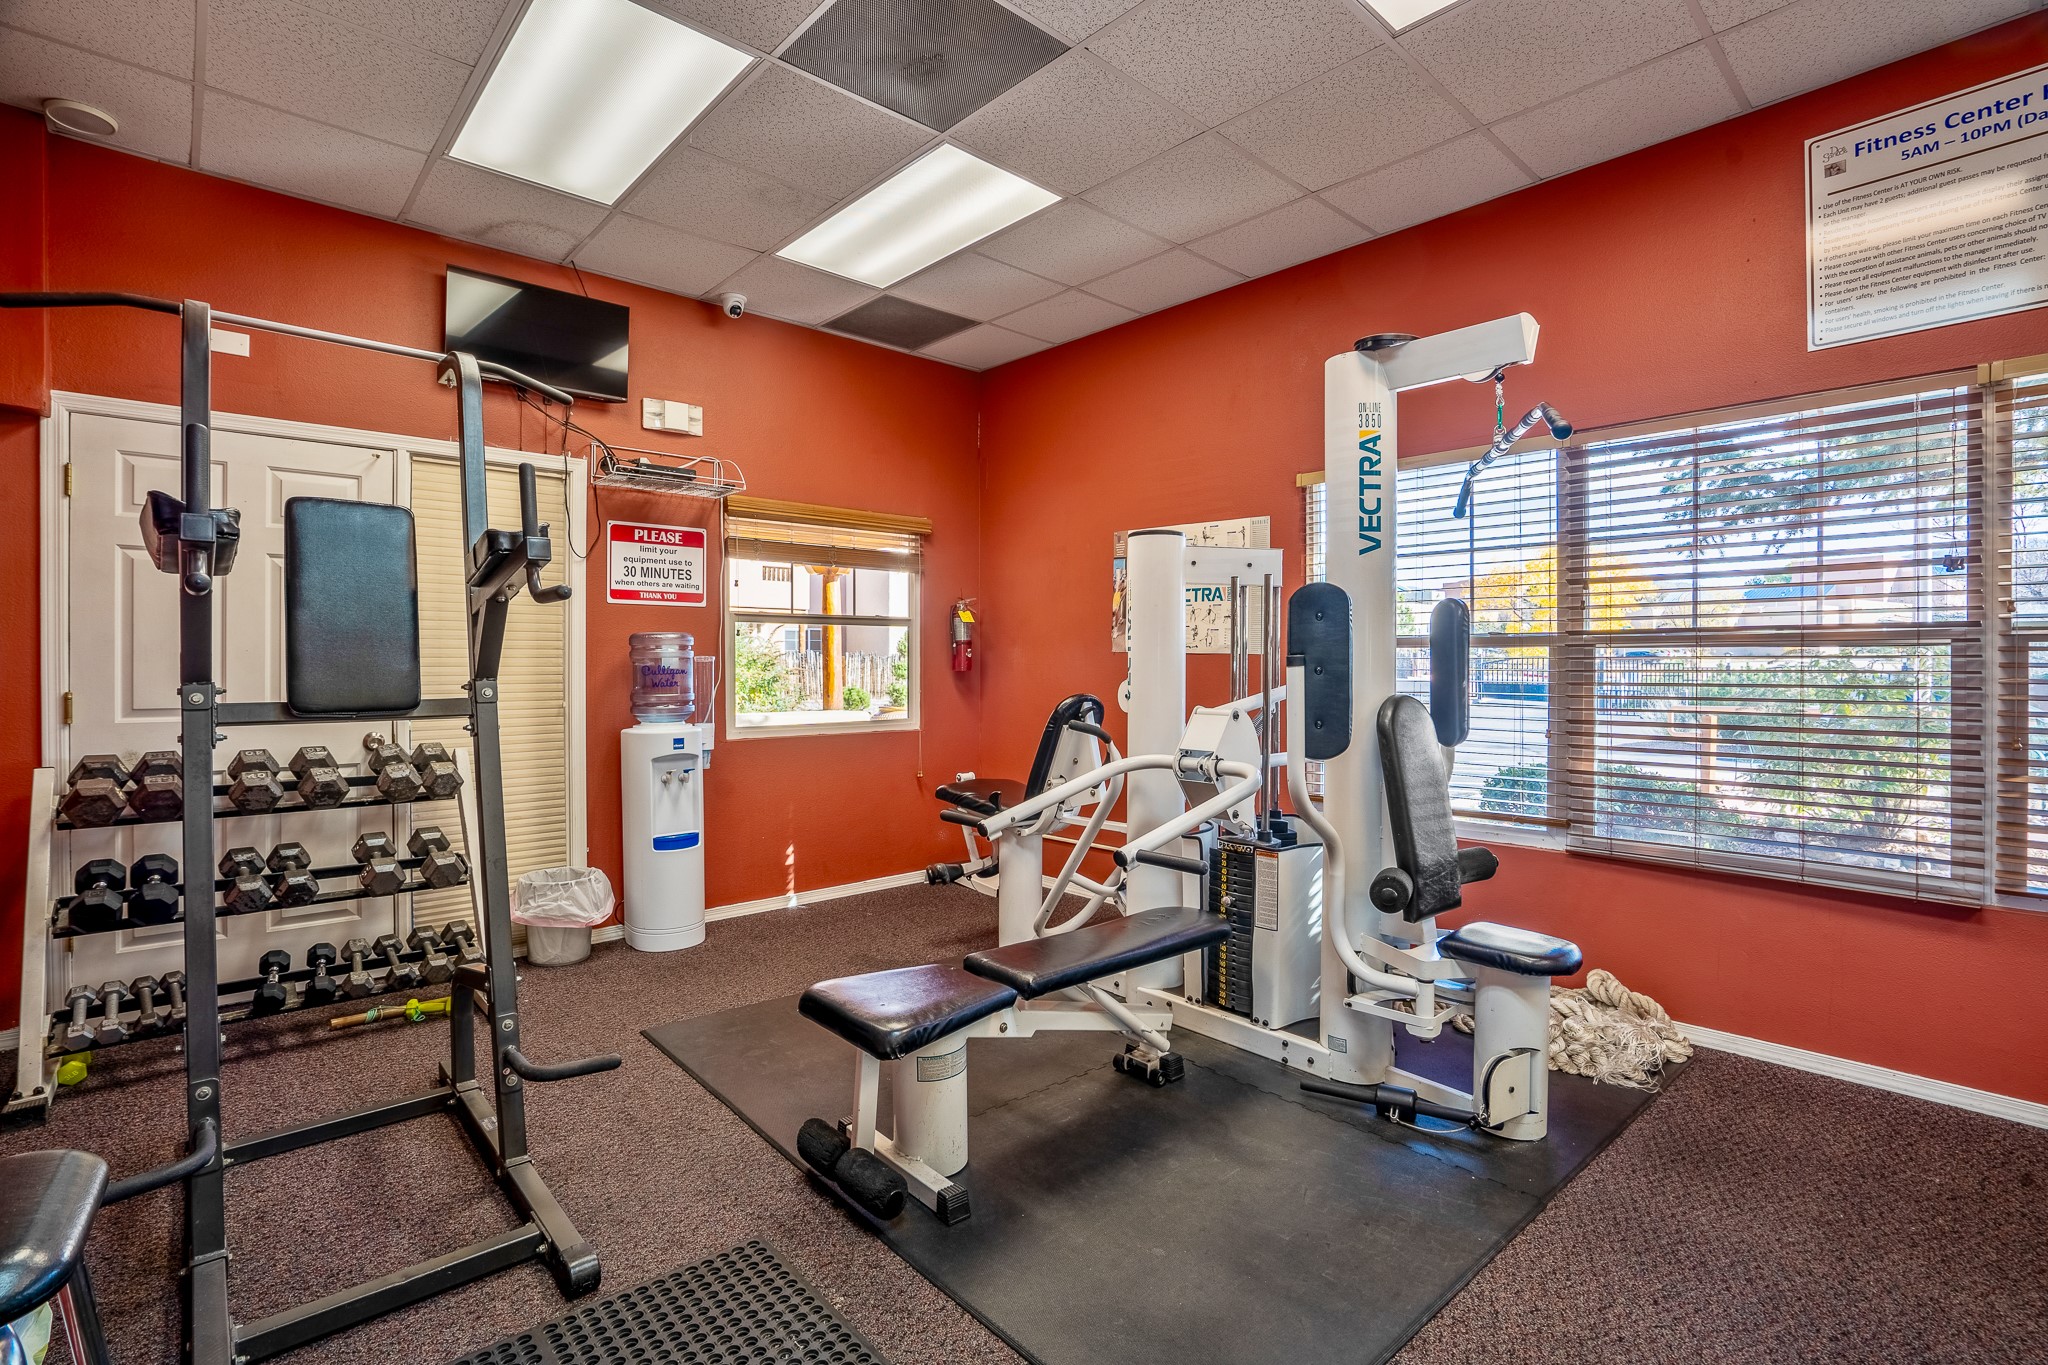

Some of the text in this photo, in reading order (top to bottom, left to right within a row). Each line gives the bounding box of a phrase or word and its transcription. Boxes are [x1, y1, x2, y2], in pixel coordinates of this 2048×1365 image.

[1854, 123, 1936, 157] Fitness
[1944, 93, 2033, 130] Center
[1901, 140, 1939, 161] 5AM
[1961, 119, 2011, 143] 10PM
[1824, 210, 1836, 218] Each
[1838, 207, 1849, 215] Unit
[1885, 193, 1905, 203] guests;
[1907, 183, 1937, 196] additional
[1939, 178, 1956, 189] guest
[1958, 173, 1979, 184] passes
[1981, 168, 1995, 176] may
[2007, 154, 2042, 169] requested
[1853, 193, 1872, 202] Fitness
[1873, 187, 1893, 196] Center
[1900, 181, 1908, 189] AT
[1910, 176, 1927, 186] YOUR
[1928, 171, 1945, 181] OWN
[1947, 167, 1963, 176] RISK.
[2020, 185, 2043, 195] Center
[1824, 263, 1842, 271] Please
[1843, 256, 1871, 267] cooperate
[1873, 251, 1885, 260] with
[1905, 243, 1925, 252] Fitness
[1927, 238, 1948, 247] Center
[1949, 233, 1966, 241] users
[1967, 224, 2003, 237] concerning
[2005, 219, 2026, 228] choice
[2028, 215, 2036, 223] of
[1829, 253, 1847, 261] others
[1859, 245, 1881, 254] waiting,
[1883, 239, 1901, 249] please
[1903, 235, 1916, 243] limit
[1918, 232, 1931, 241] your
[1933, 224, 1964, 236] maximum
[1992, 212, 2008, 221] each
[2010, 207, 2033, 217] Fitness
[1824, 272, 1838, 280] With
[1849, 264, 1877, 274] exception
[1886, 255, 1916, 266] assistance
[1917, 248, 1942, 258] animals,
[1944, 245, 1957, 253] pets
[1967, 238, 1985, 247] other
[1987, 231, 2012, 242] animals
[2014, 225, 2037, 236] should
[1825, 281, 1842, 289] Please
[1843, 276, 1861, 285] report
[1870, 267, 1902, 279] equipment
[1903, 258, 1942, 271] malfunctions
[1964, 247, 1993, 257] manager
[1994, 236, 2039, 250] immediately.
[1825, 290, 1842, 298] Please
[1870, 280, 1890, 288] Fitness
[1891, 275, 1912, 283] Center
[1913, 266, 1946, 279] equipment
[1948, 262, 1961, 271] with
[1963, 254, 2001, 267] disinfectant
[1856, 292, 1875, 300] safety,
[1890, 283, 1918, 293] following
[1934, 271, 1966, 285] prohibited
[1994, 261, 2016, 270] Fitness
[2020, 255, 2046, 264] Center:
[1825, 306, 1855, 315] containers.
[1853, 310, 1873, 318] health,
[1874, 305, 1898, 314] smoking
[1906, 296, 1937, 309] prohibited
[1958, 288, 1980, 297] Fitness
[1982, 283, 2006, 292] Center.
[1871, 315, 1897, 324] windows
[1948, 301, 1964, 309] lights
[1966, 297, 1984, 305] when
[1985, 292, 2009, 301] leaving
[1358, 402, 1381, 413] ON-LINE
[1358, 413, 1382, 429] 3850
[1358, 434, 1382, 557] VECTRA
[634, 529, 683, 544] PLEASE
[639, 545, 657, 553] limit
[623, 555, 667, 565] equipment
[623, 565, 692, 581] 30 MINUTES
[639, 591, 663, 600] THANK
[675, 582, 700, 590] waiting
[641, 664, 688, 680] Culligan
[651, 677, 680, 688] Water
